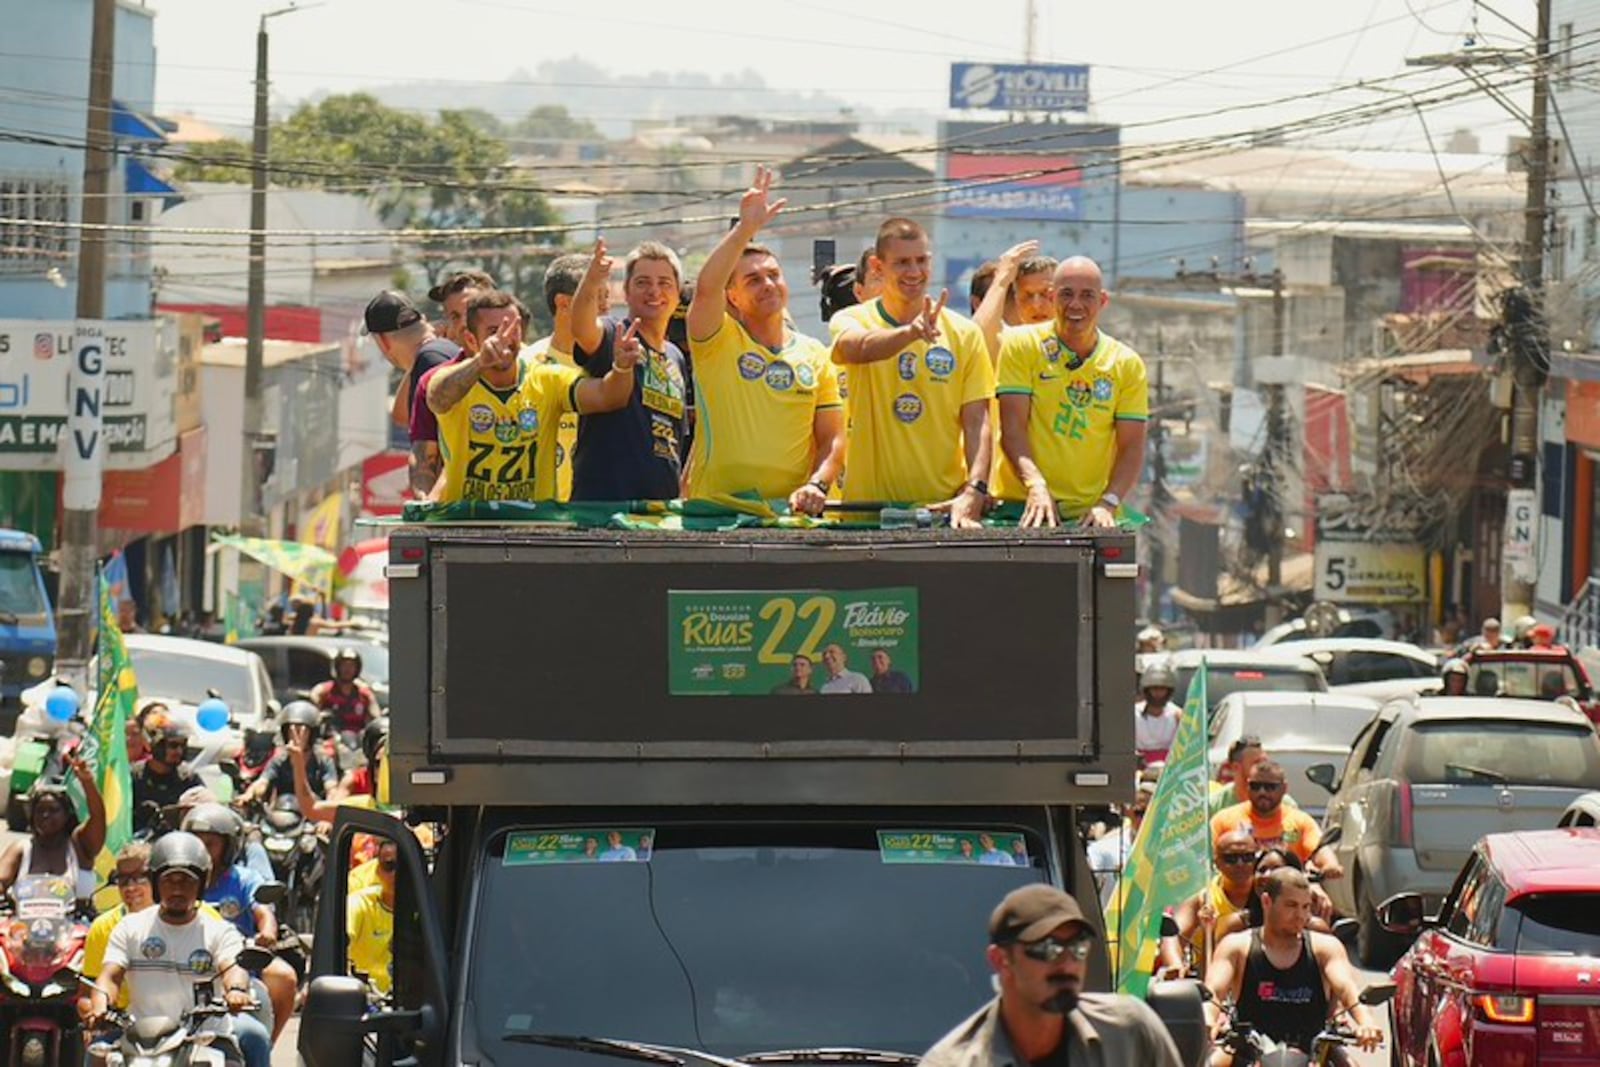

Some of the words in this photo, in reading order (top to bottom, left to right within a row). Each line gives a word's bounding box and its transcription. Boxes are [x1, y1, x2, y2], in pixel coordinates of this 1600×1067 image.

[73, 345, 102, 460] GNV
[682, 612, 754, 646] Ruas
[758, 596, 837, 664] 22
[842, 601, 910, 629] Flávio
